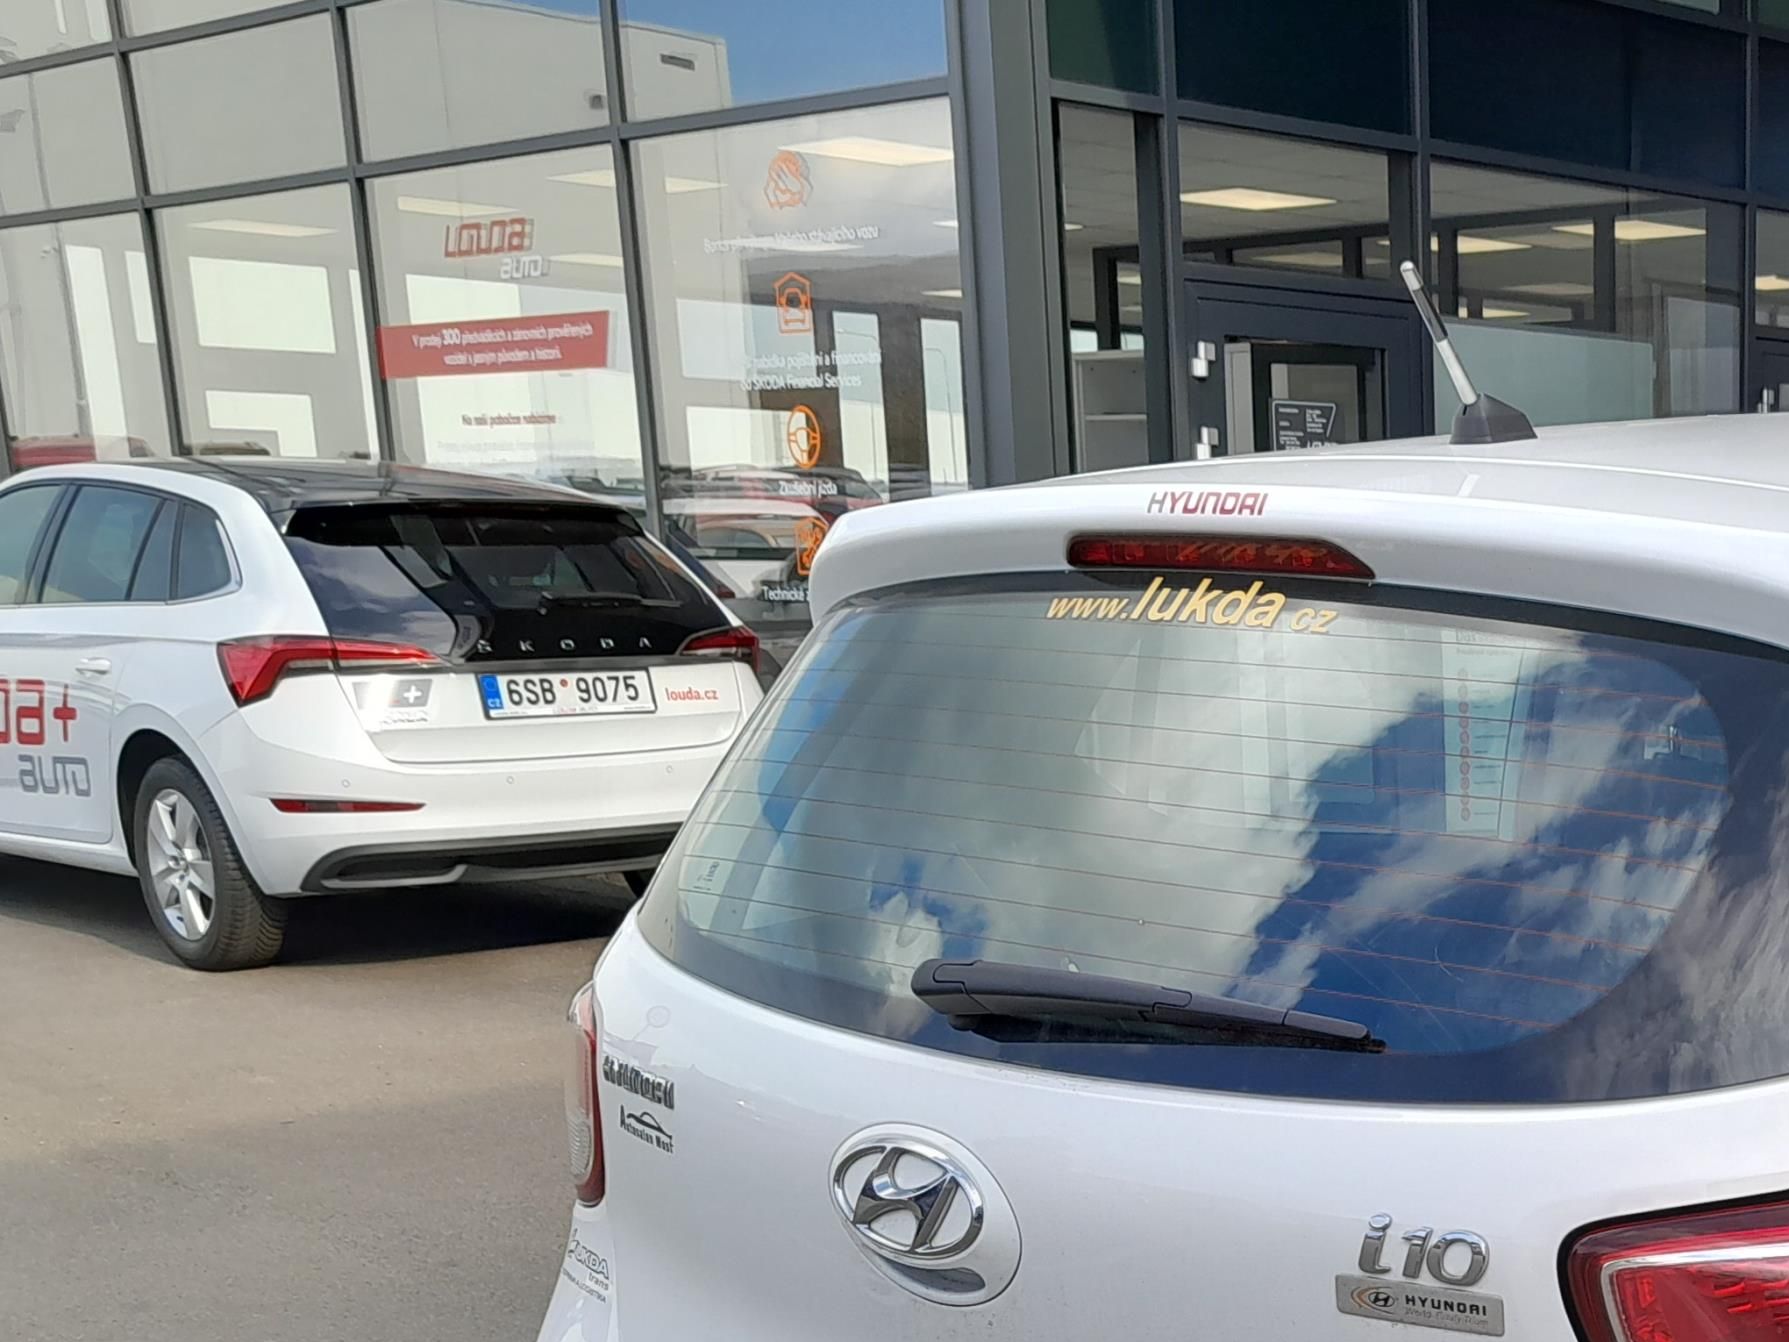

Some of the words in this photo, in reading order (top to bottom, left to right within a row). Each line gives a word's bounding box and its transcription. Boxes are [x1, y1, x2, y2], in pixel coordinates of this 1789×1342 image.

[1146, 491, 1269, 516] HYUNDAI
[506, 679, 556, 706] 6SB
[576, 675, 640, 703] 9075
[665, 687, 719, 702] louda.cz
[1358, 1212, 1490, 1286] i10
[1405, 1294, 1487, 1317] HYUNDAI
